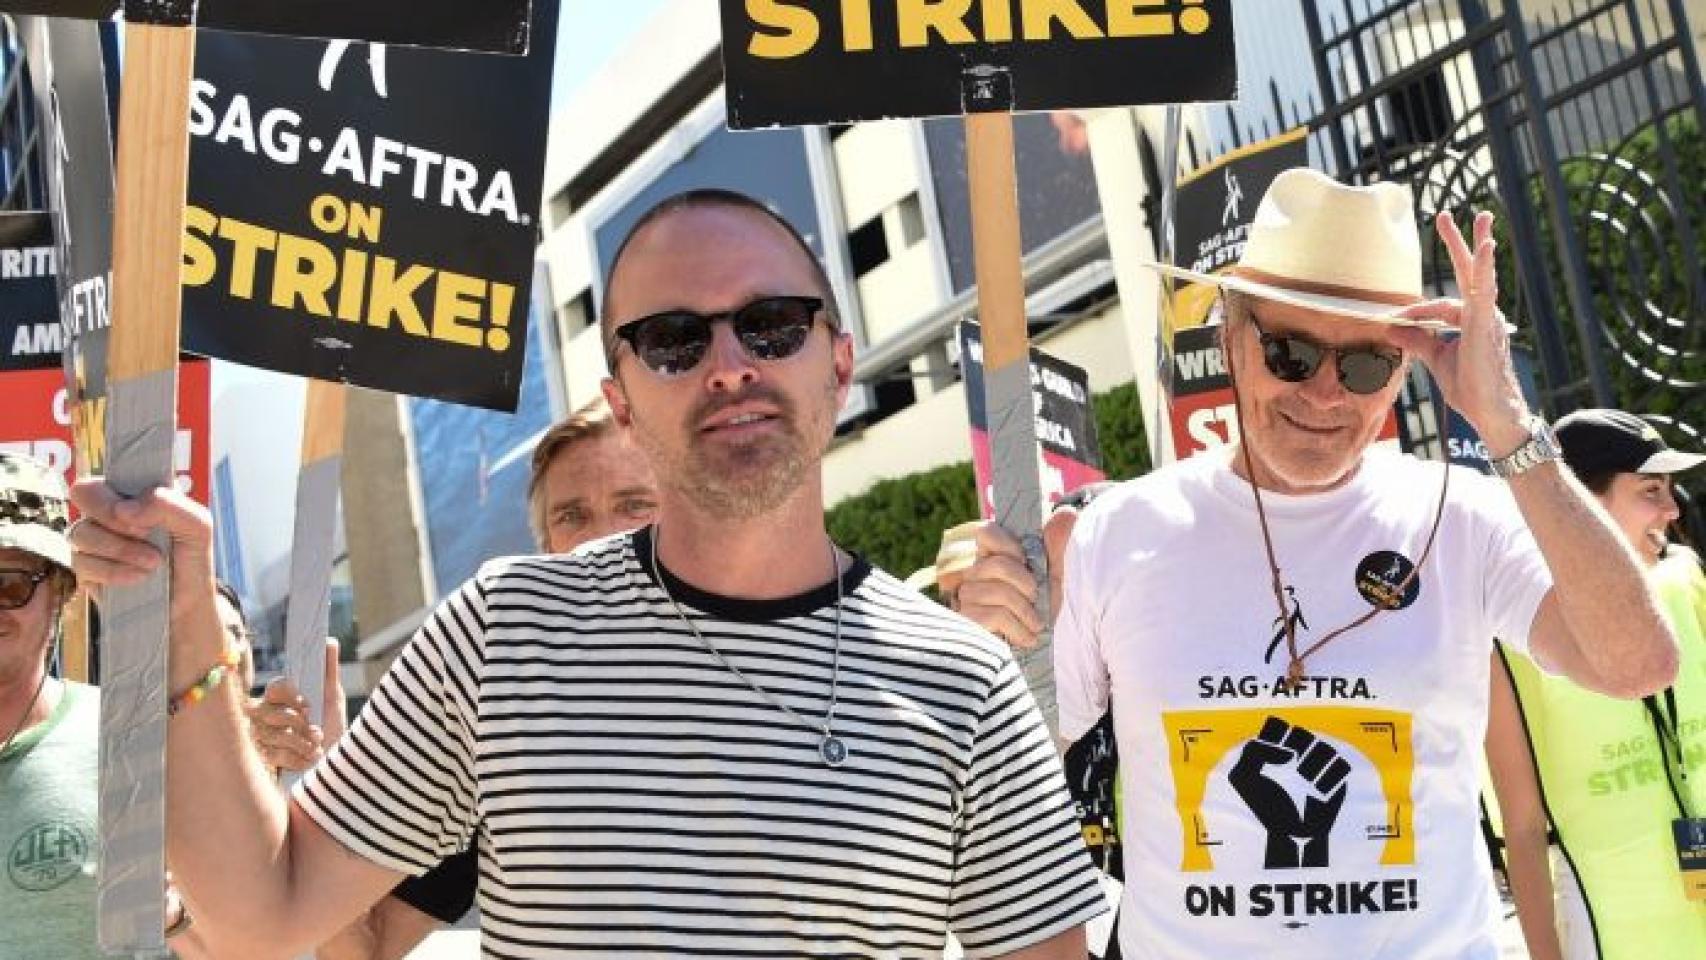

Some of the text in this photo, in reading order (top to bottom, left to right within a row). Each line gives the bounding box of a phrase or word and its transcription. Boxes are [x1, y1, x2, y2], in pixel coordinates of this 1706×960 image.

[310, 194, 383, 243] ON
[181, 204, 516, 352] STRIKE!
[1185, 878, 1418, 917] ON STRIKE!
